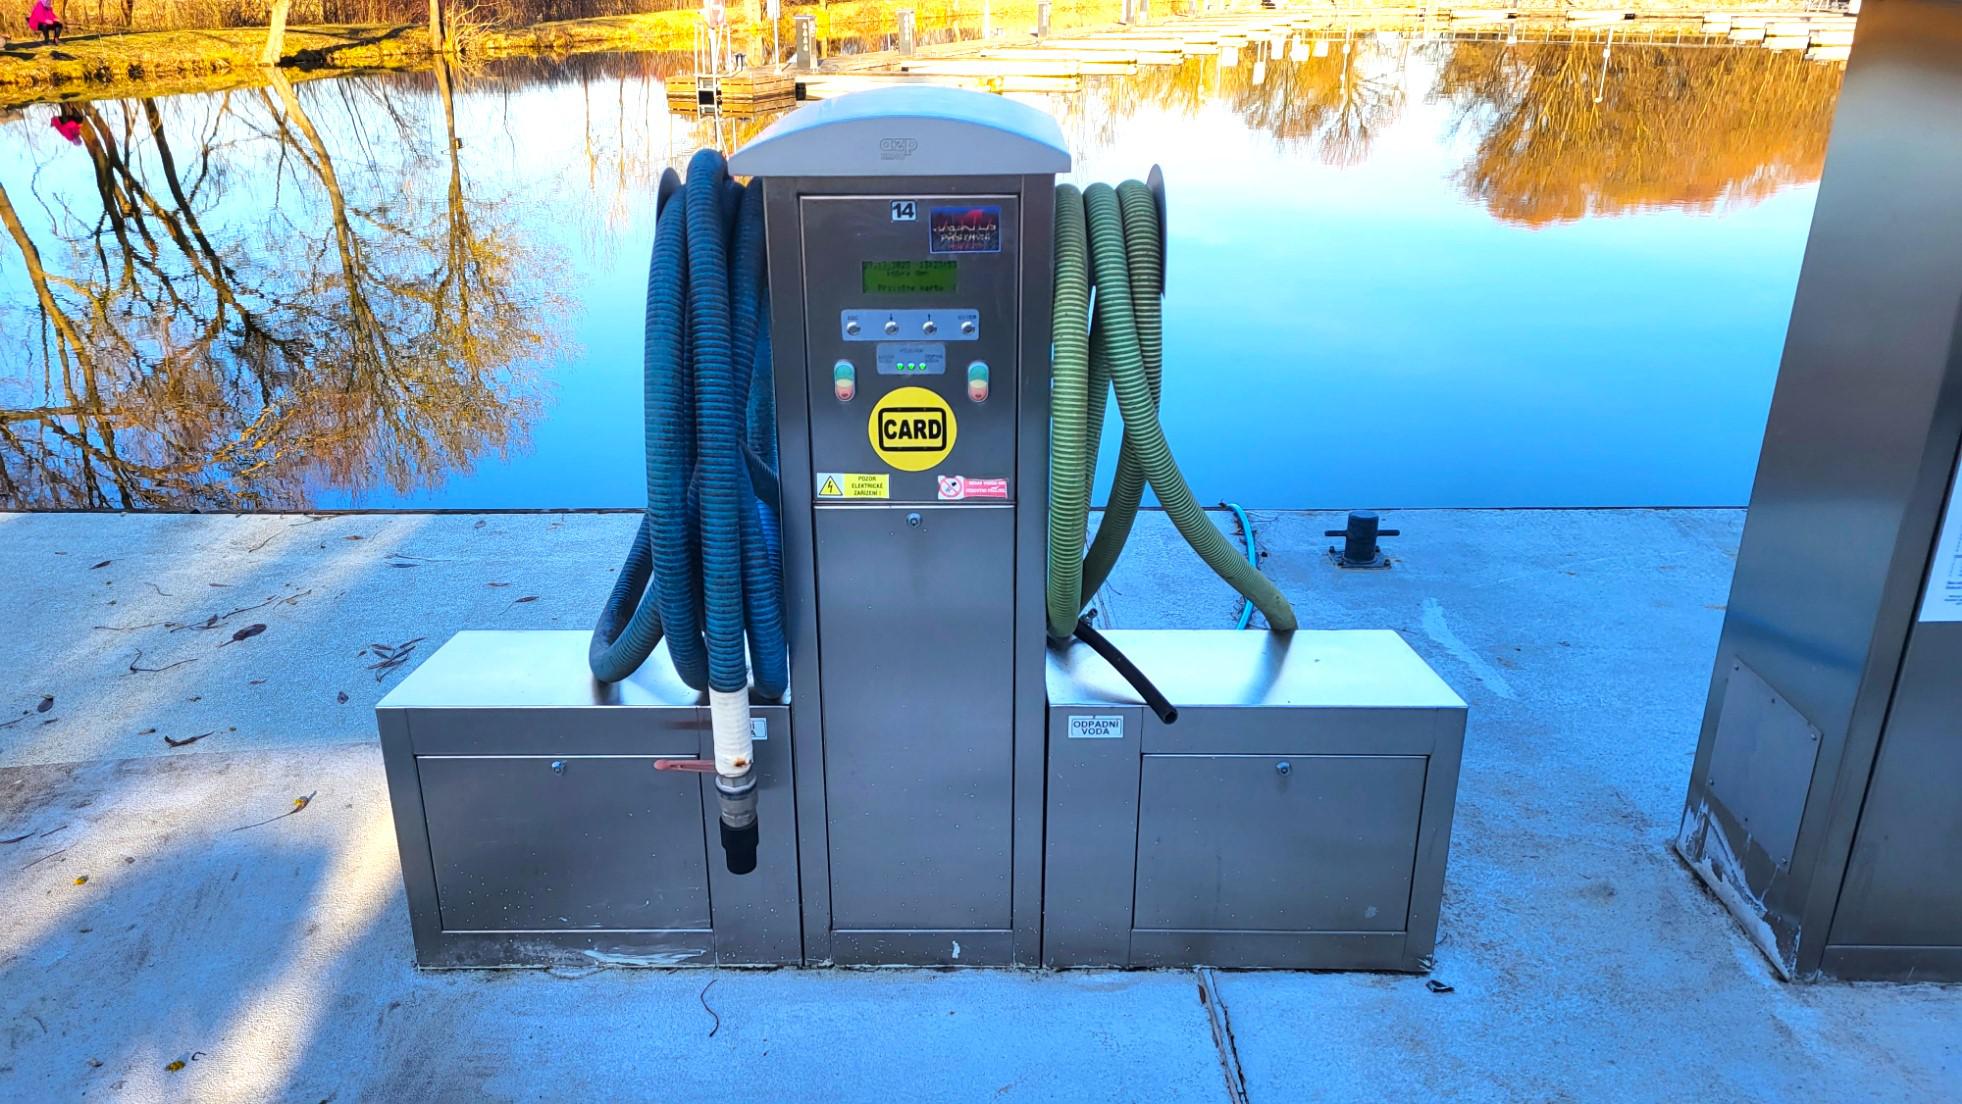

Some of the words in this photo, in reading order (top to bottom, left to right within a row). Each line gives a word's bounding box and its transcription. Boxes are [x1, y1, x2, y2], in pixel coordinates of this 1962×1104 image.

[893, 202, 914, 218] 14
[884, 419, 941, 439] CARD
[1073, 719, 1119, 728] ODPADNÍ
